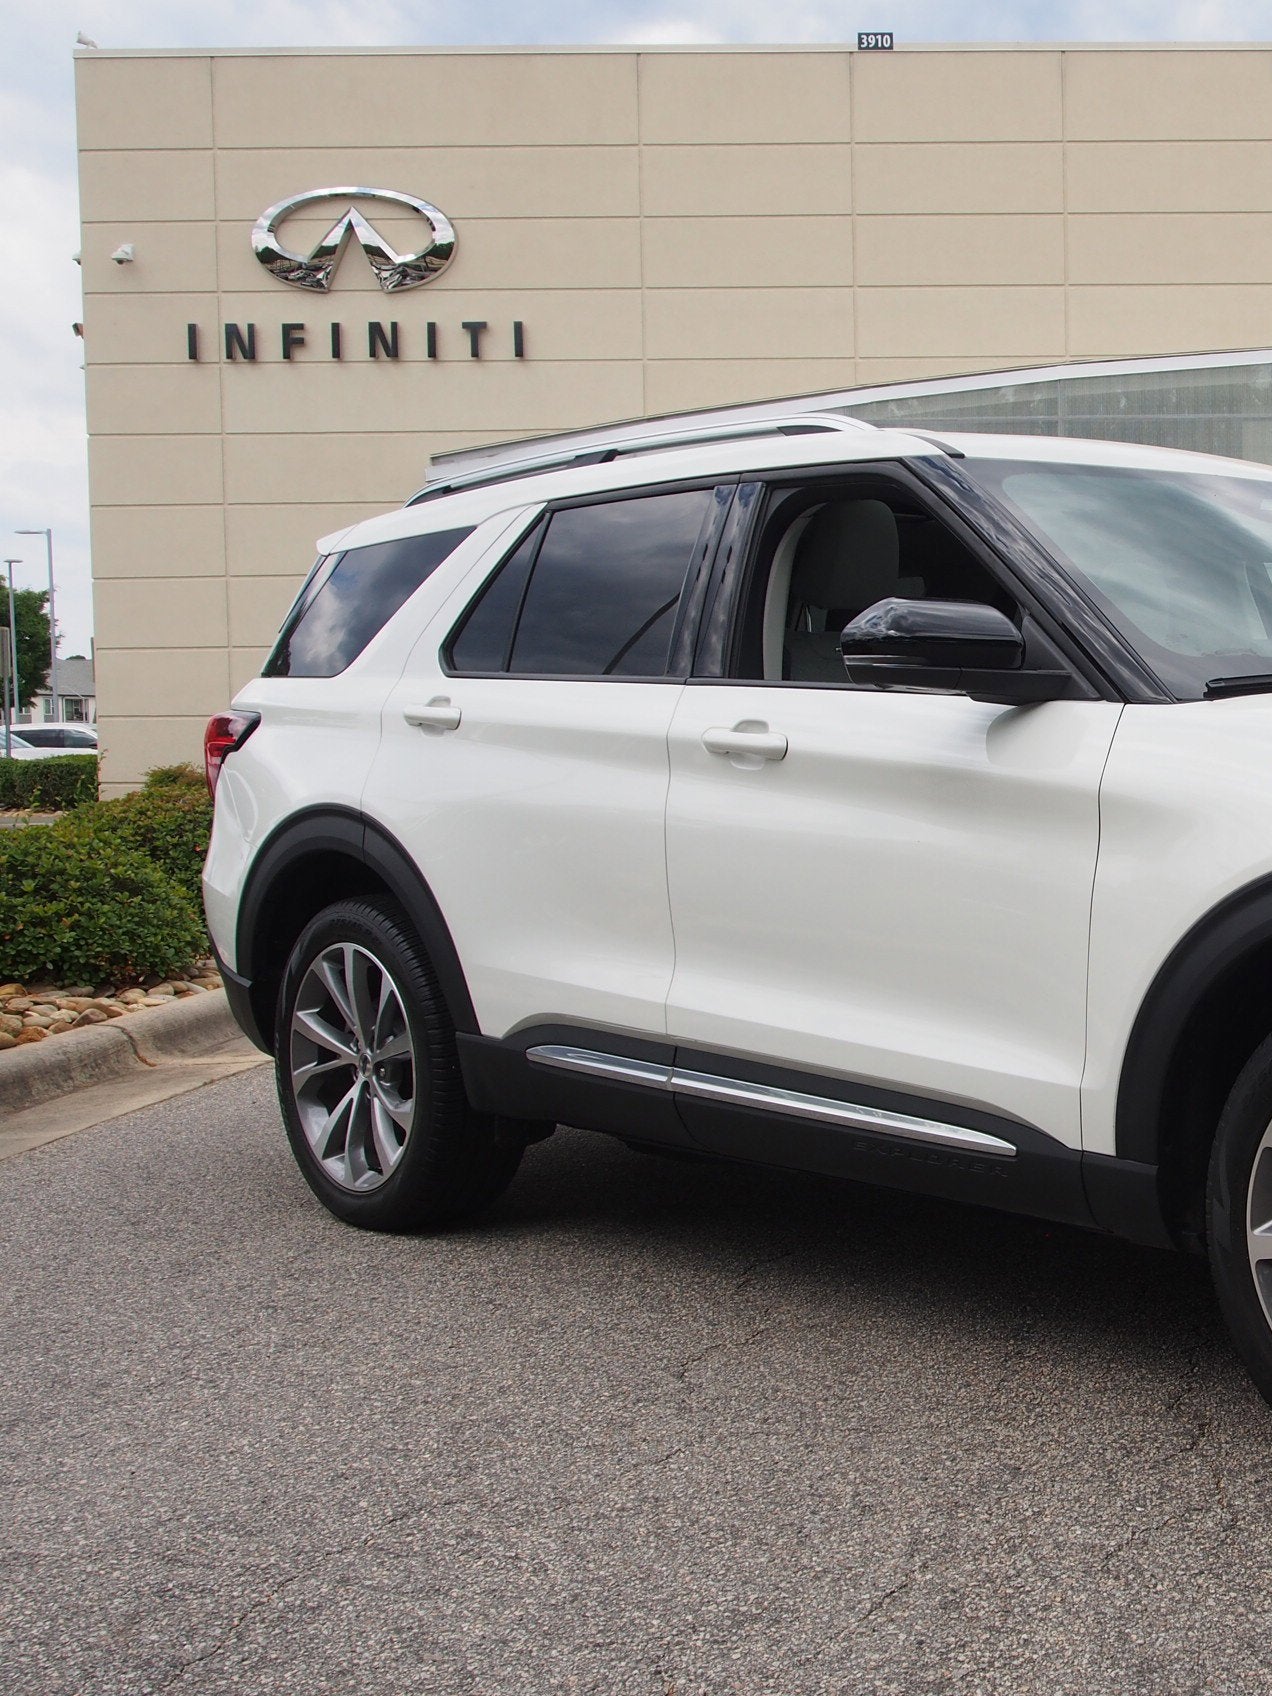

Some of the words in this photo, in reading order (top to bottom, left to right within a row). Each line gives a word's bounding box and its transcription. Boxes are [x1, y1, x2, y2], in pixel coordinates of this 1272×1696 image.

[860, 34, 891, 48] 3910
[187, 320, 525, 360] INFINITI
[852, 1140, 1009, 1178] EXPLORER
